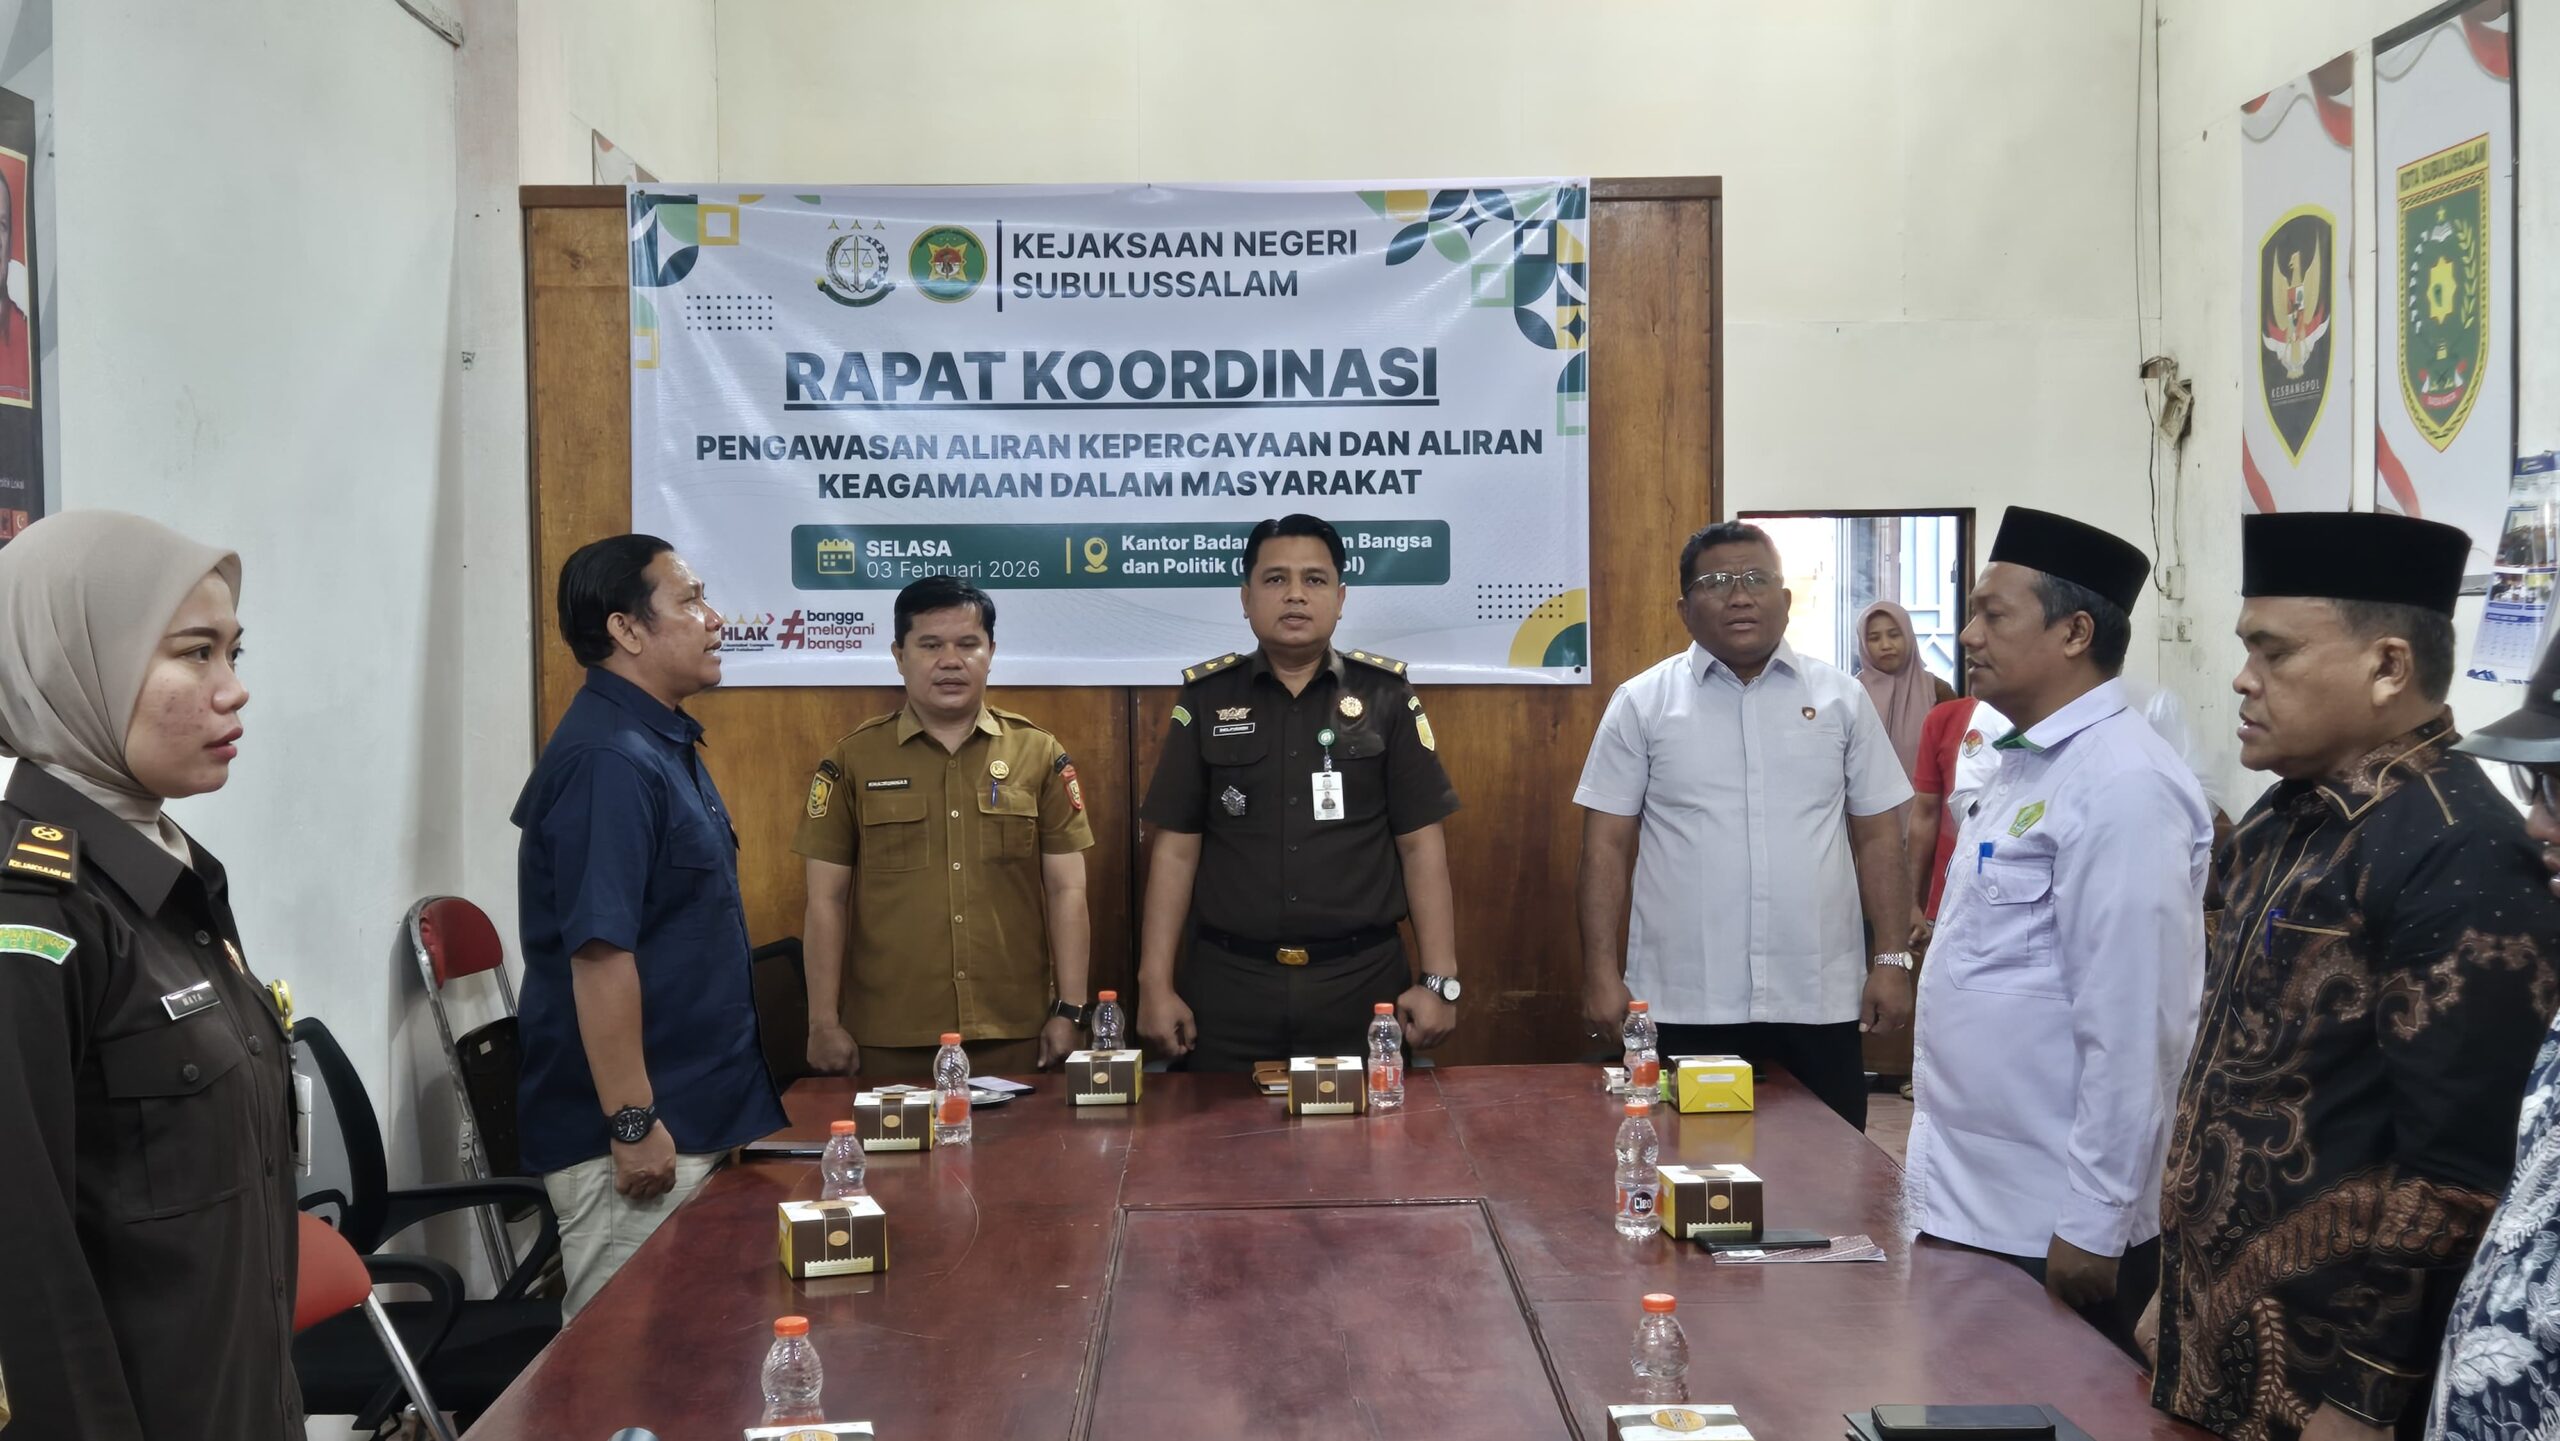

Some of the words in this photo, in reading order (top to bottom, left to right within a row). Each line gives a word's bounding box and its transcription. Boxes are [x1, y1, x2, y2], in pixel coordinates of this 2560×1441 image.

[1013, 231, 1224, 259] KEJAKSAAN
[1234, 229, 1357, 257] NEGERI
[1012, 270, 1298, 299] SUBULUSSALAM
[786, 351, 1007, 402] RAPAT
[1023, 346, 1437, 401] KOORDINASI
[697, 435, 938, 460] PENGAWASAN
[946, 434, 1071, 460] ALIRAN
[1079, 432, 1331, 459] KEPERCAYAAN
[1340, 430, 1410, 456] DAN
[1418, 429, 1543, 456] ALIRAN
[818, 473, 1043, 499] KEAGAMAAN
[1051, 471, 1174, 497] DALAM
[1181, 469, 1423, 496] MASYARAKAT
[866, 540, 952, 557] SELASA
[1122, 535, 1190, 550] Kantor
[1358, 533, 1433, 552] Bangsa
[866, 562, 892, 578] 03
[900, 560, 982, 578] Februari
[989, 560, 1040, 578] 2026
[1122, 559, 1159, 574] dan
[1164, 557, 1227, 574] Politik
[807, 610, 864, 624] bangga
[807, 623, 875, 638] melayani
[807, 637, 862, 652] bangsa
